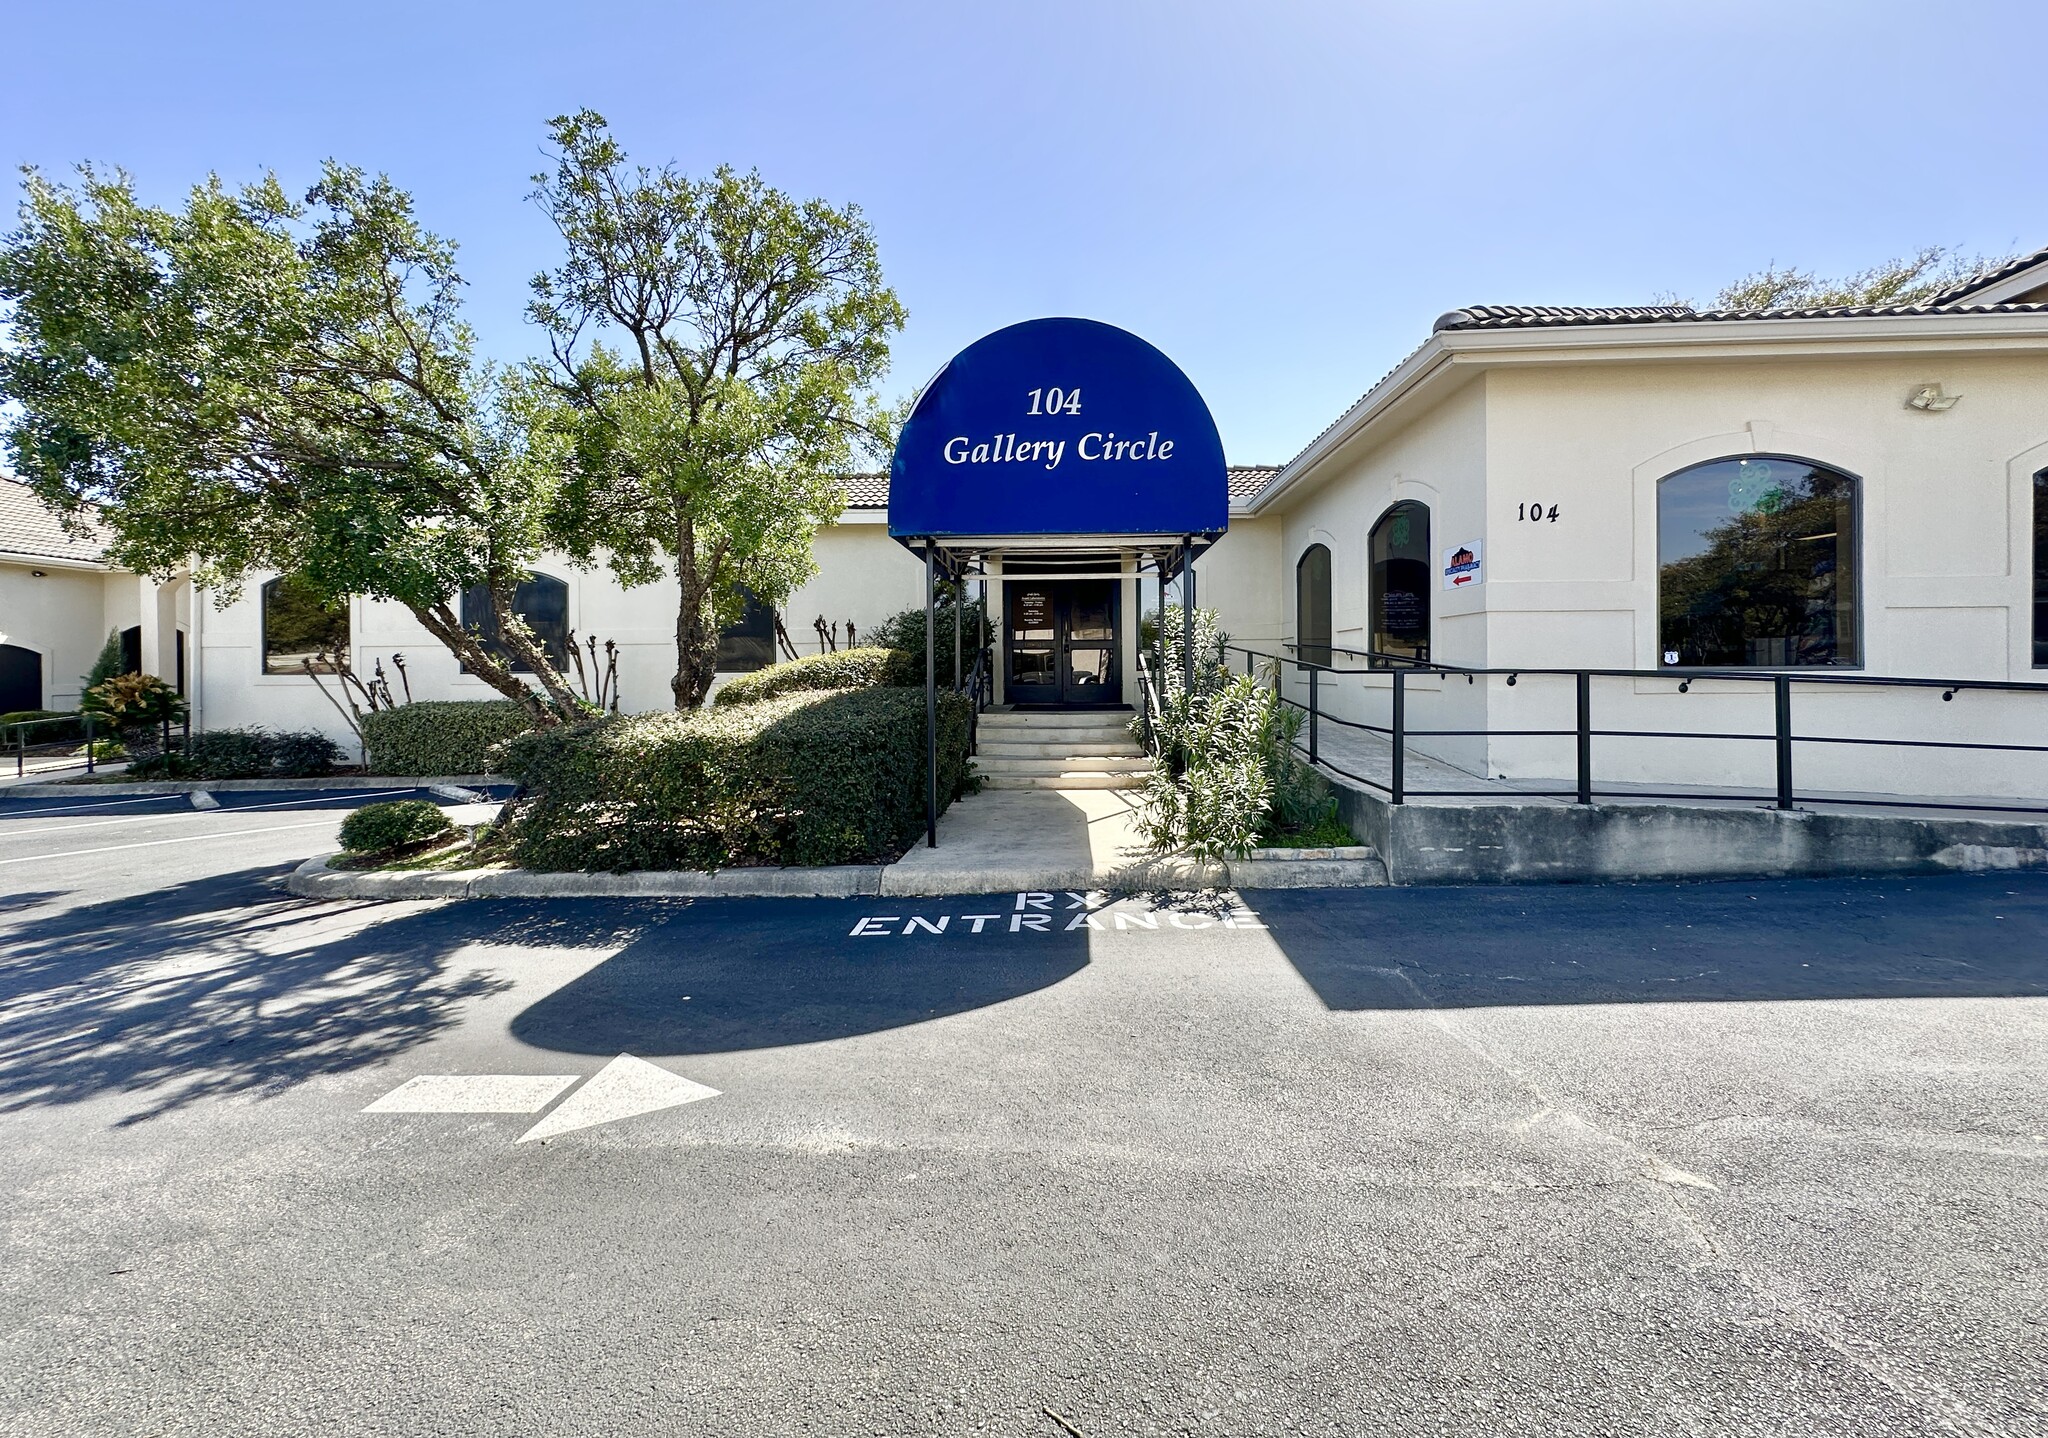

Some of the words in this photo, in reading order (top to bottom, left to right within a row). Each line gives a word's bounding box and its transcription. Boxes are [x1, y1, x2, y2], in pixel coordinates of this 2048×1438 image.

[1027, 387, 1082, 415] 104
[944, 433, 1066, 470] Gallery
[1078, 431, 1174, 461] Circle
[1518, 502, 1560, 523] 104
[1451, 551, 1474, 567] ALAMO
[1013, 892, 1108, 911] RX
[848, 911, 1271, 937] ENTRANCE
